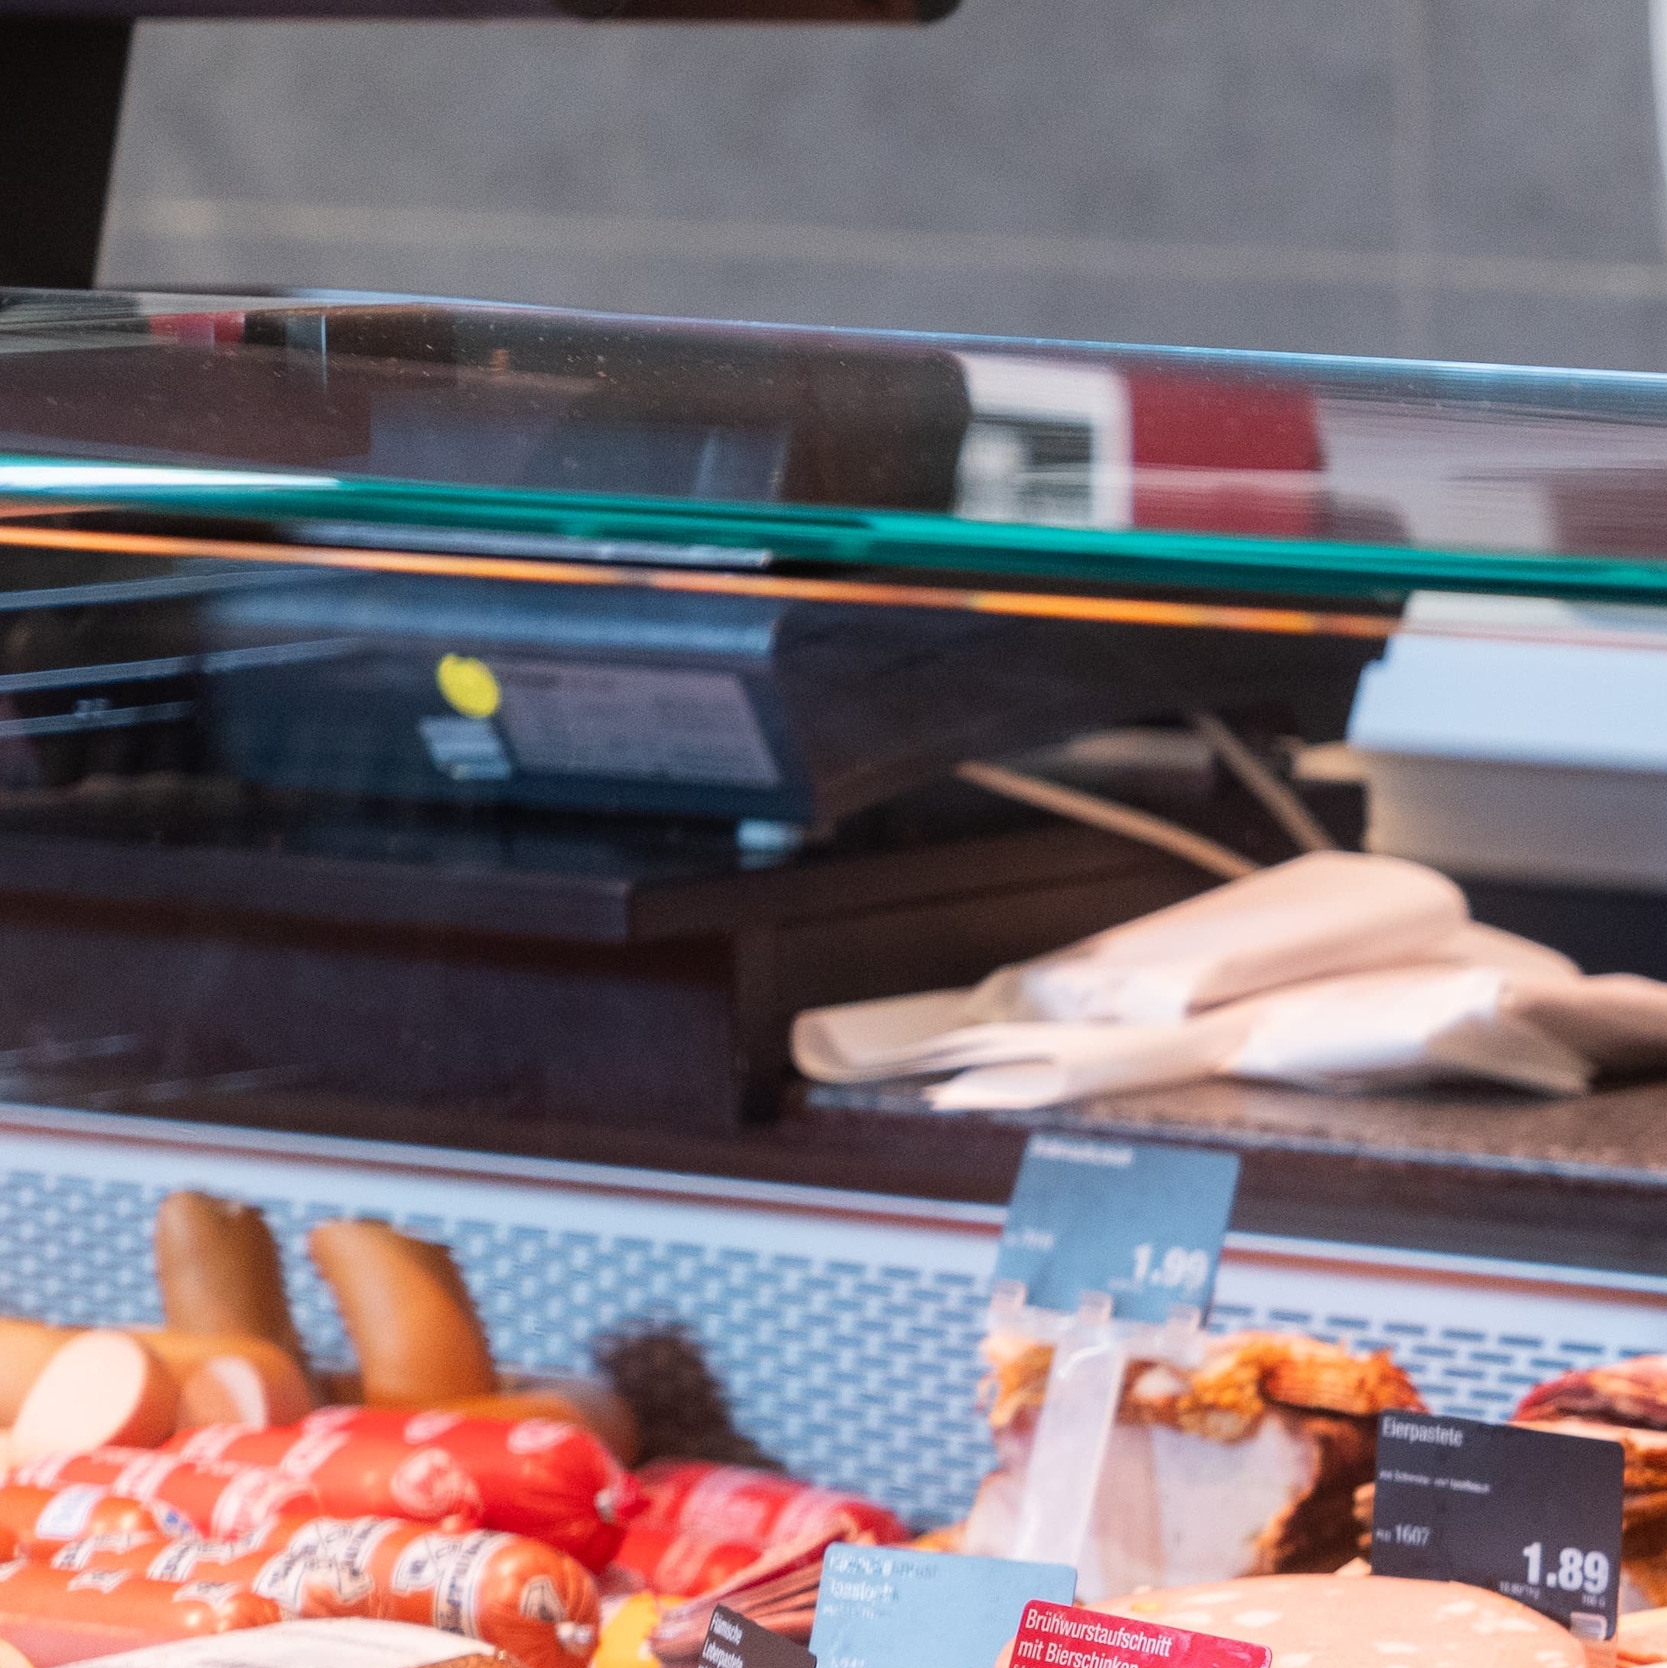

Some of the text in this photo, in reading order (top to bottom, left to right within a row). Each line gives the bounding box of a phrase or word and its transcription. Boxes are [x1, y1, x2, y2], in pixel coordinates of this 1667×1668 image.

[1133, 1243, 1209, 1292] 1.99
[1383, 1416, 1463, 1447] Eierpastete
[1395, 1523, 1430, 1547] 1607
[1523, 1541, 1609, 1594] 1.89
[1018, 1639, 1043, 1660] mit
[1025, 1608, 1172, 1657] Brühwurstaufschnitt
